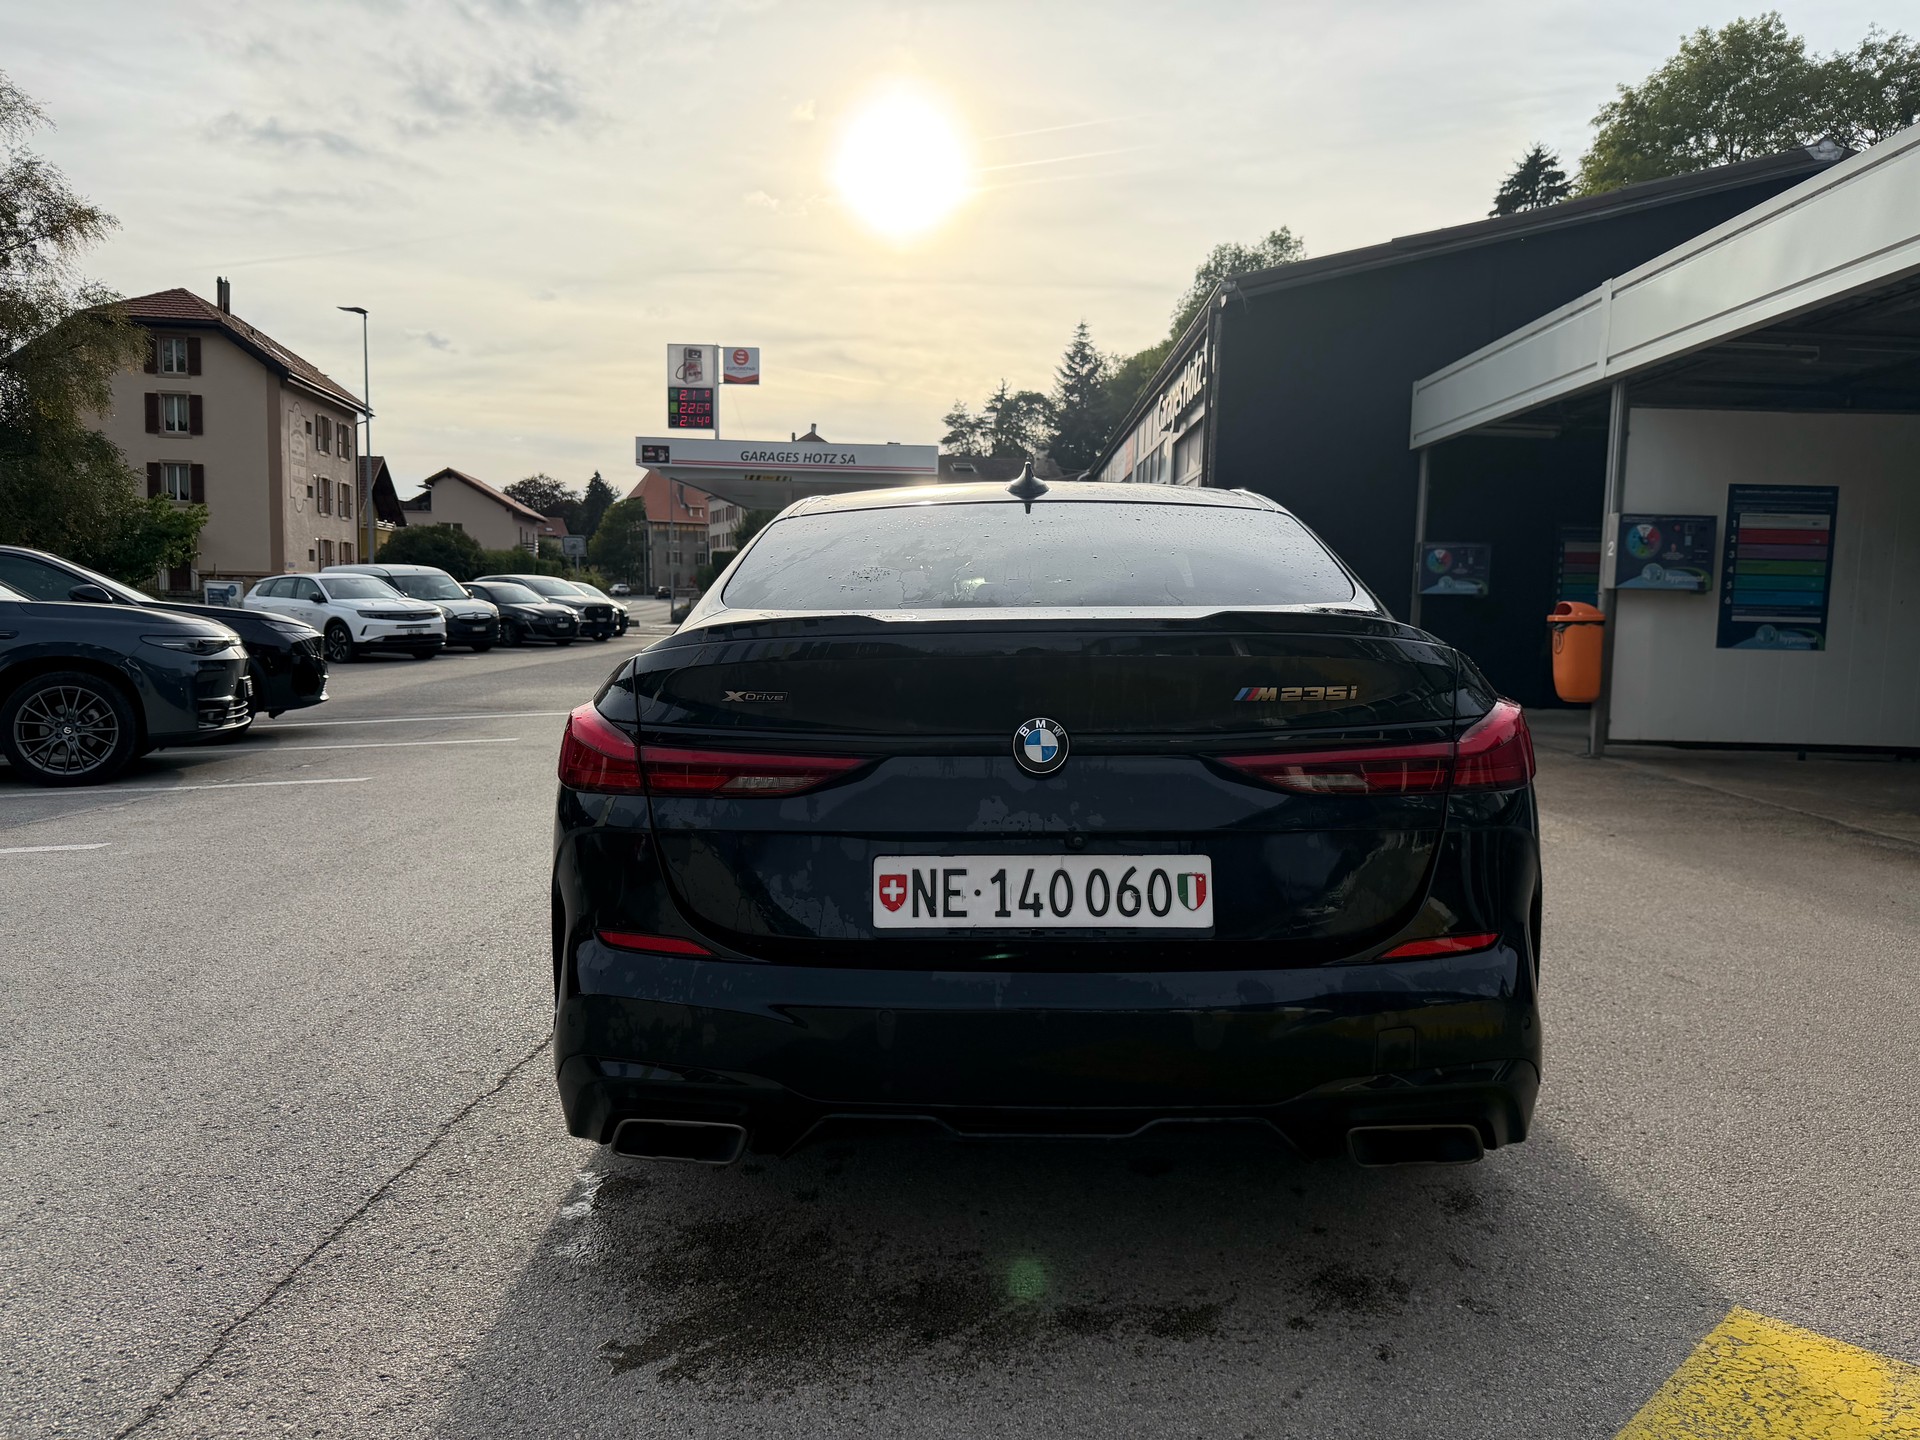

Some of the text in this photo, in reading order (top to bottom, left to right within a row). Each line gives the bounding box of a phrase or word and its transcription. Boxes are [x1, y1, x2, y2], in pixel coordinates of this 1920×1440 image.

[740, 450, 856, 465] GARAGES HOTZ SA
[1607, 540, 1615, 557] 2
[1019, 719, 1063, 737] BMW
